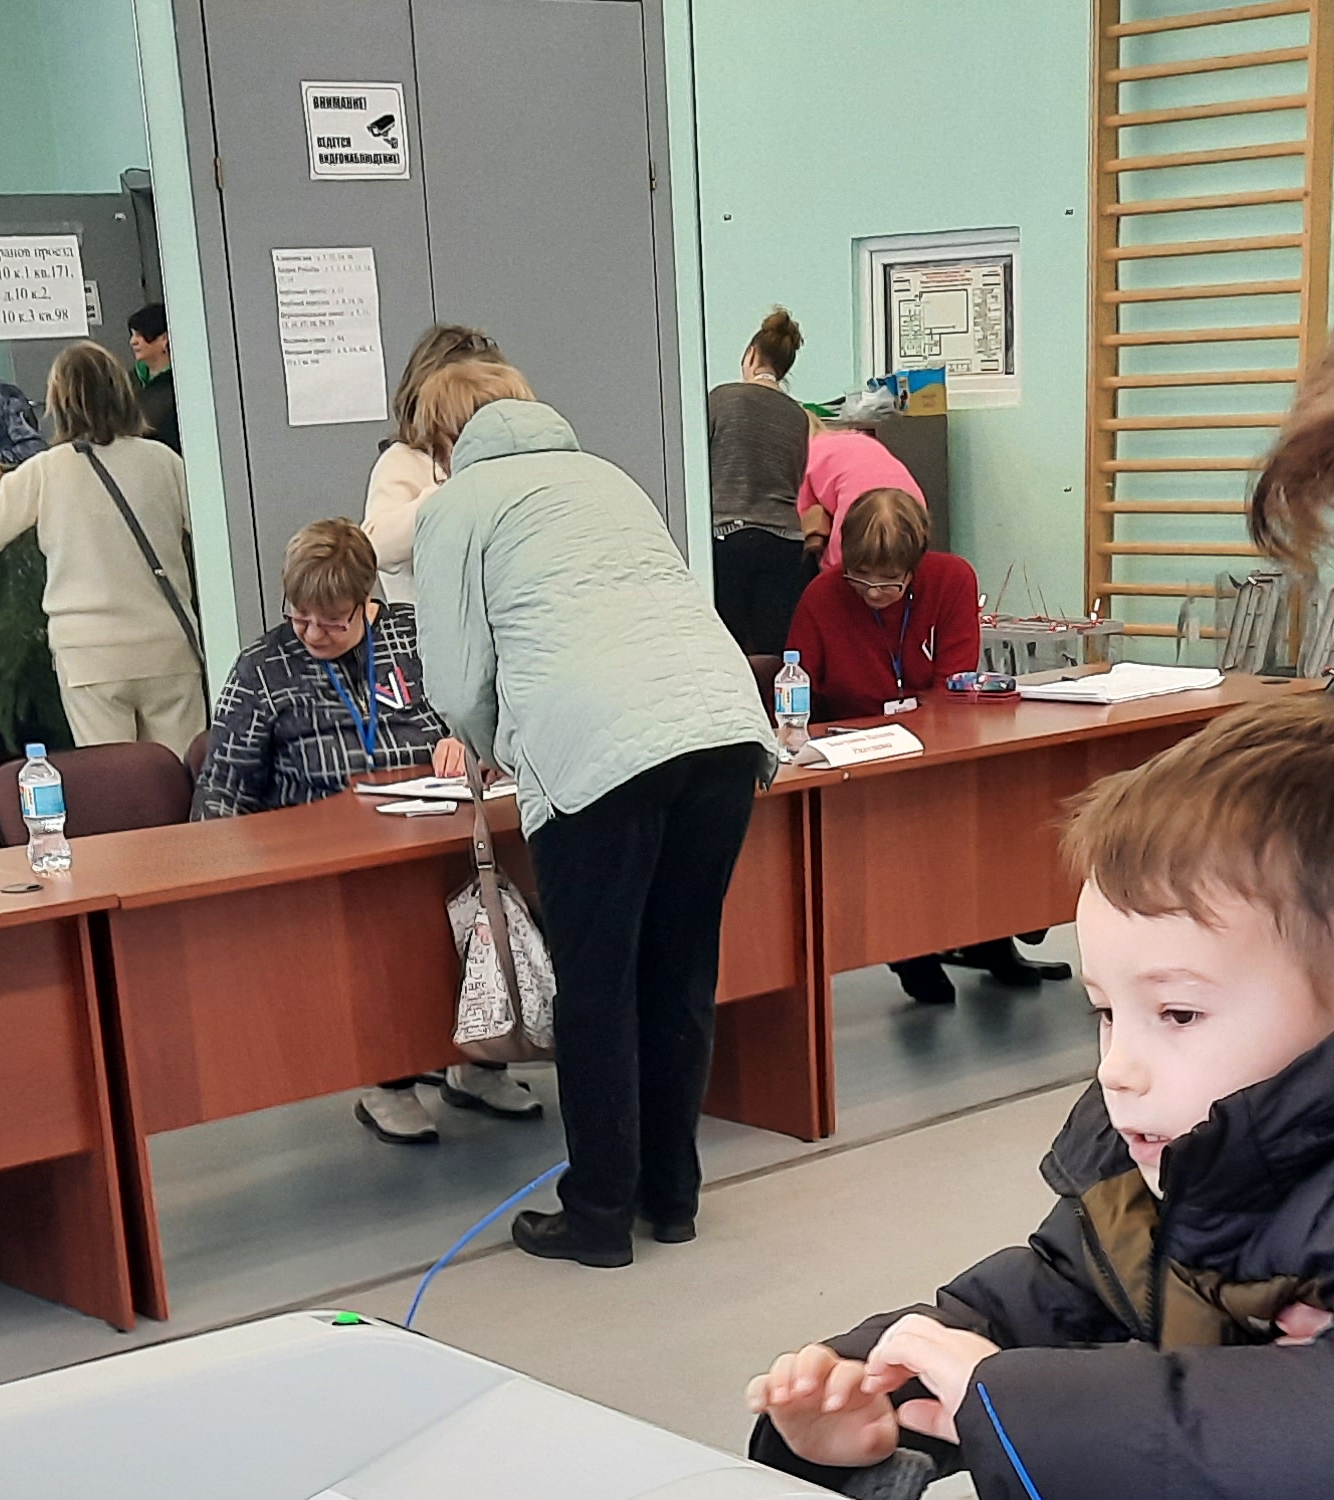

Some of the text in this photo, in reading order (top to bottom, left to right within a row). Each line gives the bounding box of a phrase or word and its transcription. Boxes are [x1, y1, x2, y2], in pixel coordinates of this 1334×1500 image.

[34, 246, 74, 260] проезд
[14, 266, 29, 279] к.1
[34, 265, 74, 279] кв.171,
[4, 287, 27, 302] д.10
[38, 308, 69, 322] кв.98
